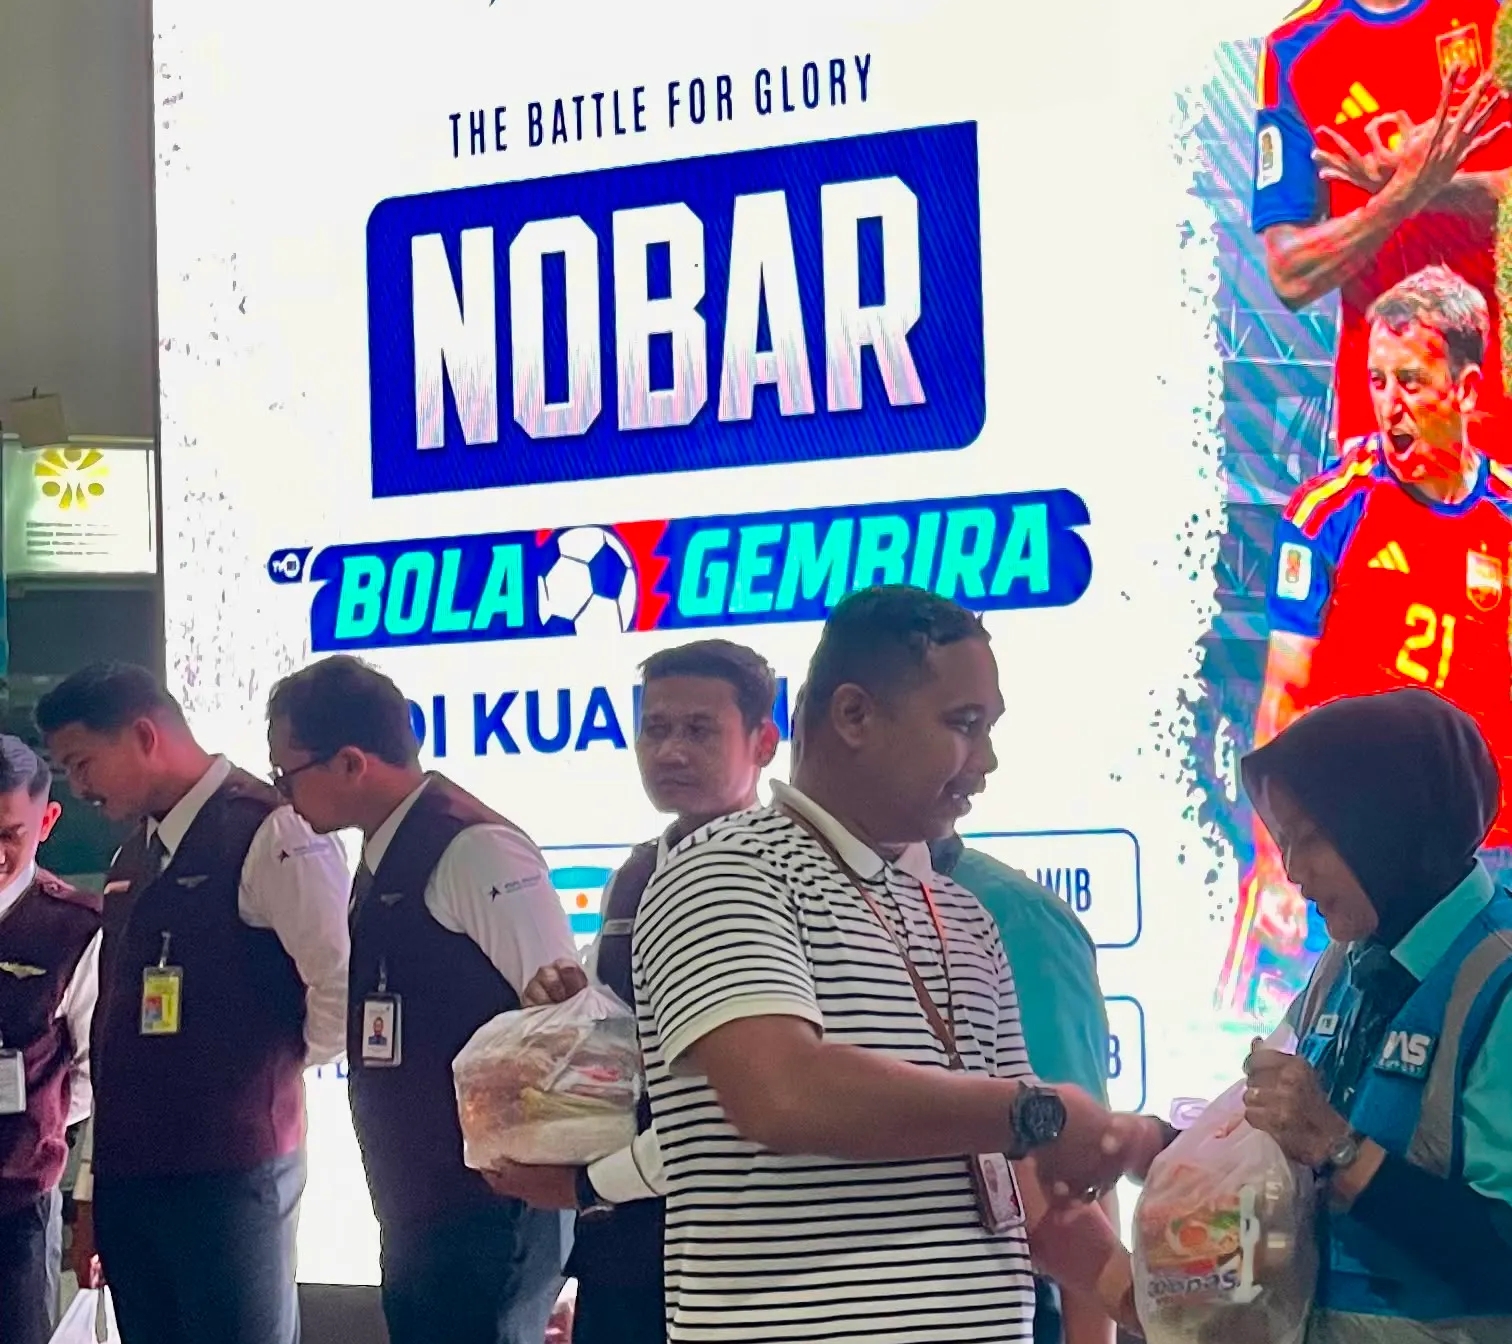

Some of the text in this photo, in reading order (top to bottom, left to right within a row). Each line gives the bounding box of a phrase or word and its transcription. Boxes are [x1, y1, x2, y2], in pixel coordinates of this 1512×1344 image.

[448, 52, 872, 159] THE BATTLE FOR GLORY
[410, 175, 927, 451] NOBAR
[333, 503, 1051, 640] BOLA GEMBIRA
[1395, 603, 1457, 690] 21
